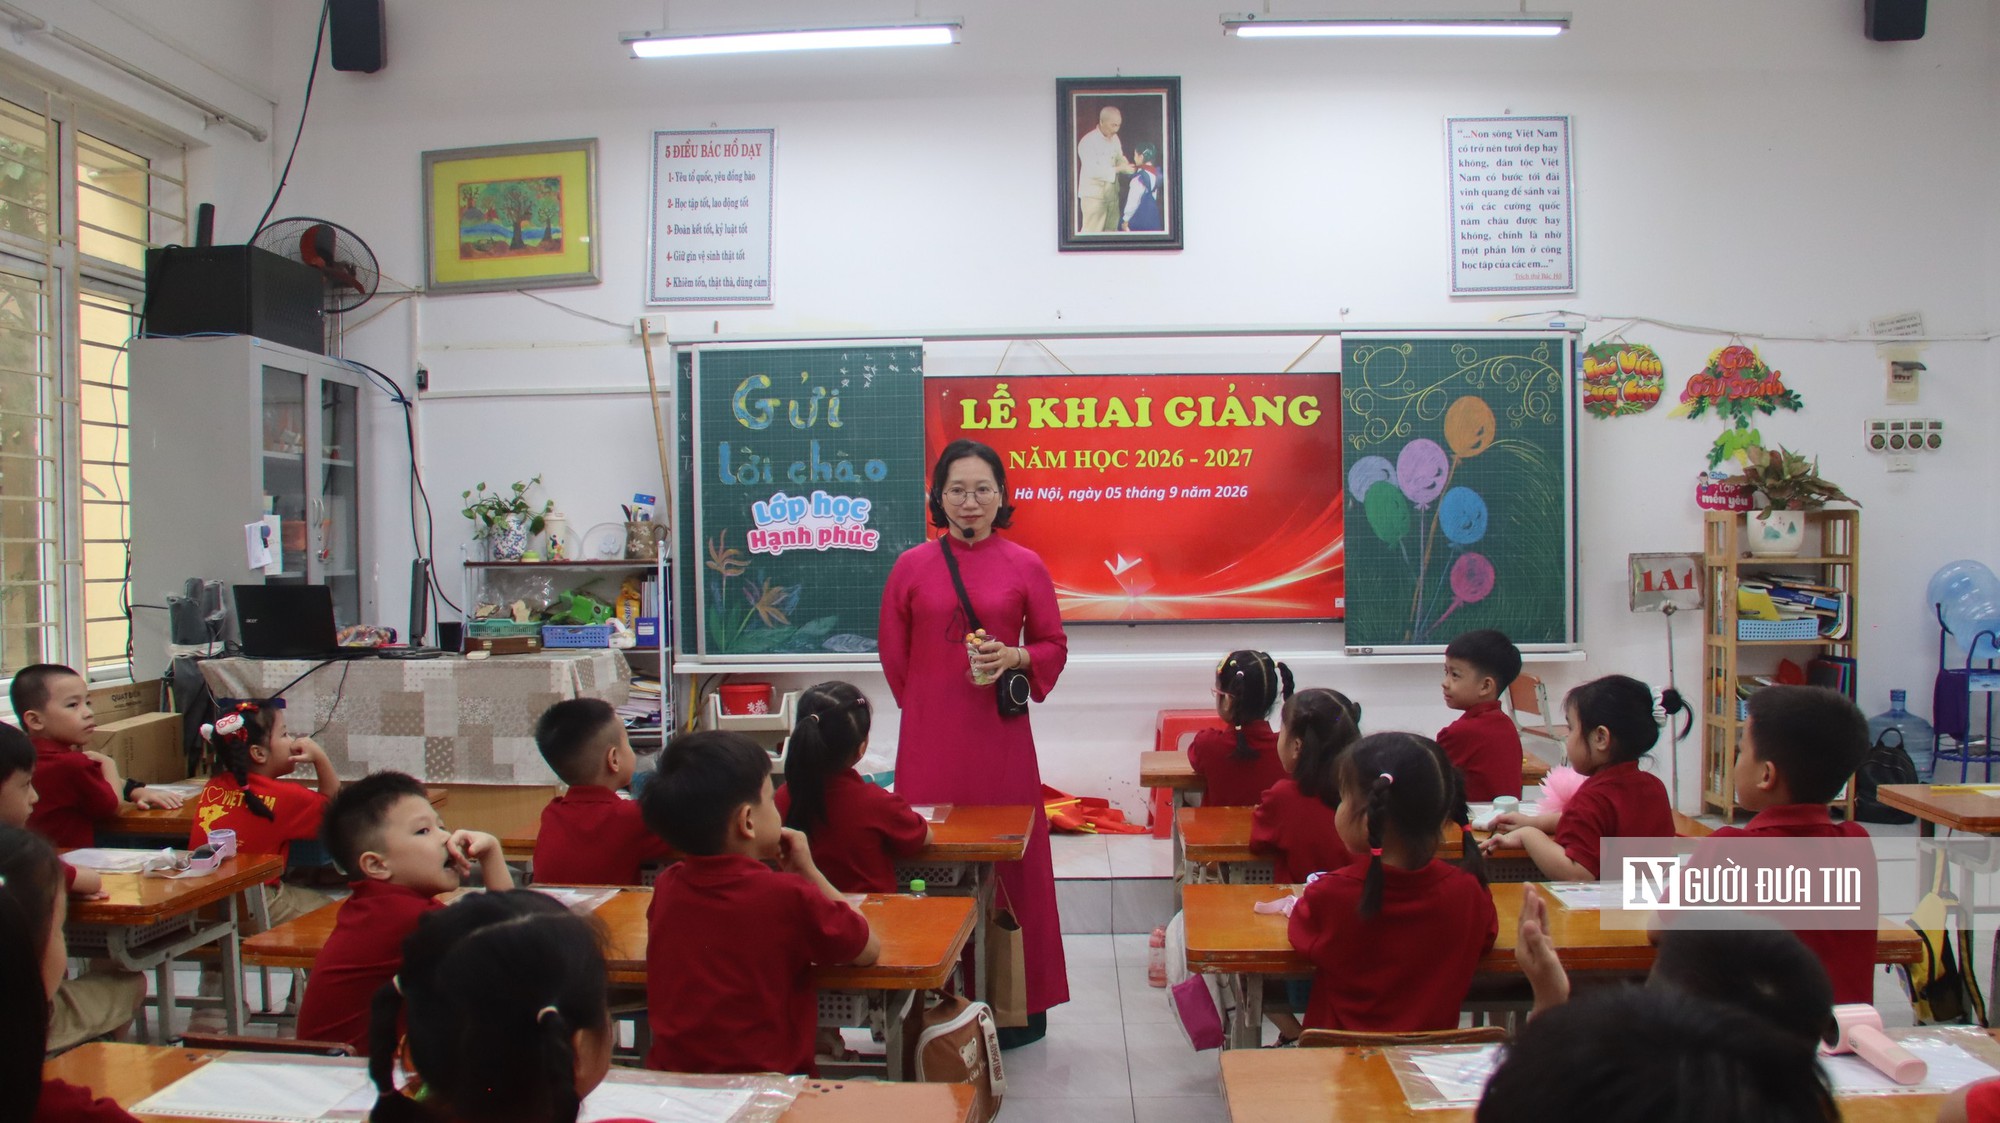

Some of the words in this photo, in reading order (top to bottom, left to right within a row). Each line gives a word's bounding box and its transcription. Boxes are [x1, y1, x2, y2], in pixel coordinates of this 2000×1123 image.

[1492, 130, 1512, 139] sông
[1516, 129, 1534, 140] Việt
[1537, 129, 1558, 138] Nam
[665, 145, 671, 158] 5
[673, 139, 698, 158] ĐIỀU
[701, 141, 722, 158] BÁC
[724, 138, 738, 157] HỒ
[741, 144, 762, 160] DẠY
[1458, 144, 1468, 152] có
[1486, 144, 1502, 152] nên
[1504, 144, 1522, 152] tươi
[1524, 144, 1540, 154] đẹp
[1542, 144, 1558, 154] hay
[1458, 159, 1489, 168] không,
[1496, 158, 1512, 166] dân
[1520, 158, 1534, 167] tộc
[1542, 158, 1558, 168] Việt
[675, 171, 687, 182] Yêu
[688, 169, 696, 182] tổ
[696, 170, 713, 184] quốc,
[714, 172, 725, 183] yêu
[744, 170, 756, 180] bào
[1486, 172, 1496, 181] có
[1546, 172, 1560, 180] đài
[1460, 188, 1479, 196] vinh
[1482, 188, 1509, 198] quang
[1512, 186, 1522, 196] để
[1524, 188, 1544, 196] sánh
[1547, 187, 1560, 196] vai
[675, 198, 687, 210] Học
[688, 198, 698, 210] tập
[700, 196, 710, 208] tốt,
[712, 197, 722, 208] lao
[723, 197, 738, 210] động
[740, 196, 748, 208] tốt
[1460, 202, 1474, 210] với
[1482, 202, 1496, 210] các
[1504, 202, 1531, 210] cường
[1539, 201, 1560, 212] quốc
[1488, 217, 1508, 225] châu
[1516, 216, 1538, 226] được
[1544, 216, 1560, 226] hay
[674, 224, 690, 234] Đoàn
[692, 222, 702, 234] kết
[704, 222, 714, 236] tốt,
[724, 223, 737, 236] luật
[738, 222, 748, 234] tốt
[1461, 232, 1492, 240] không,
[1498, 230, 1522, 240] chính
[1530, 230, 1538, 239] là
[1544, 230, 1562, 239] nhờ
[674, 250, 685, 262] Giữ
[686, 250, 696, 263] gìn
[698, 250, 706, 263] vệ
[707, 250, 720, 261] sinh
[722, 250, 736, 263] thật
[736, 248, 744, 260] tốt
[1462, 246, 1478, 256] một
[1512, 246, 1525, 254] lớn
[1530, 244, 1536, 253] ở
[1541, 246, 1562, 254] công
[1462, 262, 1477, 271] học
[1479, 262, 1494, 271] tập
[1495, 260, 1510, 268] của
[1512, 260, 1527, 268] các
[673, 276, 694, 288] Khiêm
[695, 276, 707, 288] tốn,
[708, 276, 722, 290] thật
[736, 276, 752, 290] dũng
[754, 275, 768, 287] cảm
[1616, 350, 1663, 378] Viện
[733, 371, 843, 430] Gửi
[960, 383, 1018, 430] LỄ
[1028, 396, 1152, 429] KHAI
[1164, 383, 1322, 428] GIẢNG
[788, 440, 888, 484] chào
[1009, 446, 1067, 470] NĂM
[1074, 449, 1129, 473] HỌC
[1135, 449, 1184, 468] 2026
[1204, 448, 1252, 468] 2027
[1014, 488, 1033, 500] Hà
[1037, 487, 1064, 501] Nội,
[1068, 488, 1102, 501] ngày
[1105, 486, 1122, 498] 05
[1126, 486, 1166, 500] tháng
[1169, 486, 1178, 498] 9
[1181, 486, 1210, 498] năm
[1214, 486, 1248, 498] 2026
[1702, 490, 1726, 504] mến
[1728, 495, 1748, 509] yêu
[755, 494, 805, 524] Lớp
[814, 492, 867, 522] học
[750, 527, 811, 550] Hạnh
[818, 525, 876, 547] phúc
[1638, 568, 1697, 592] 1A1
[222, 790, 245, 809] VIỆT
